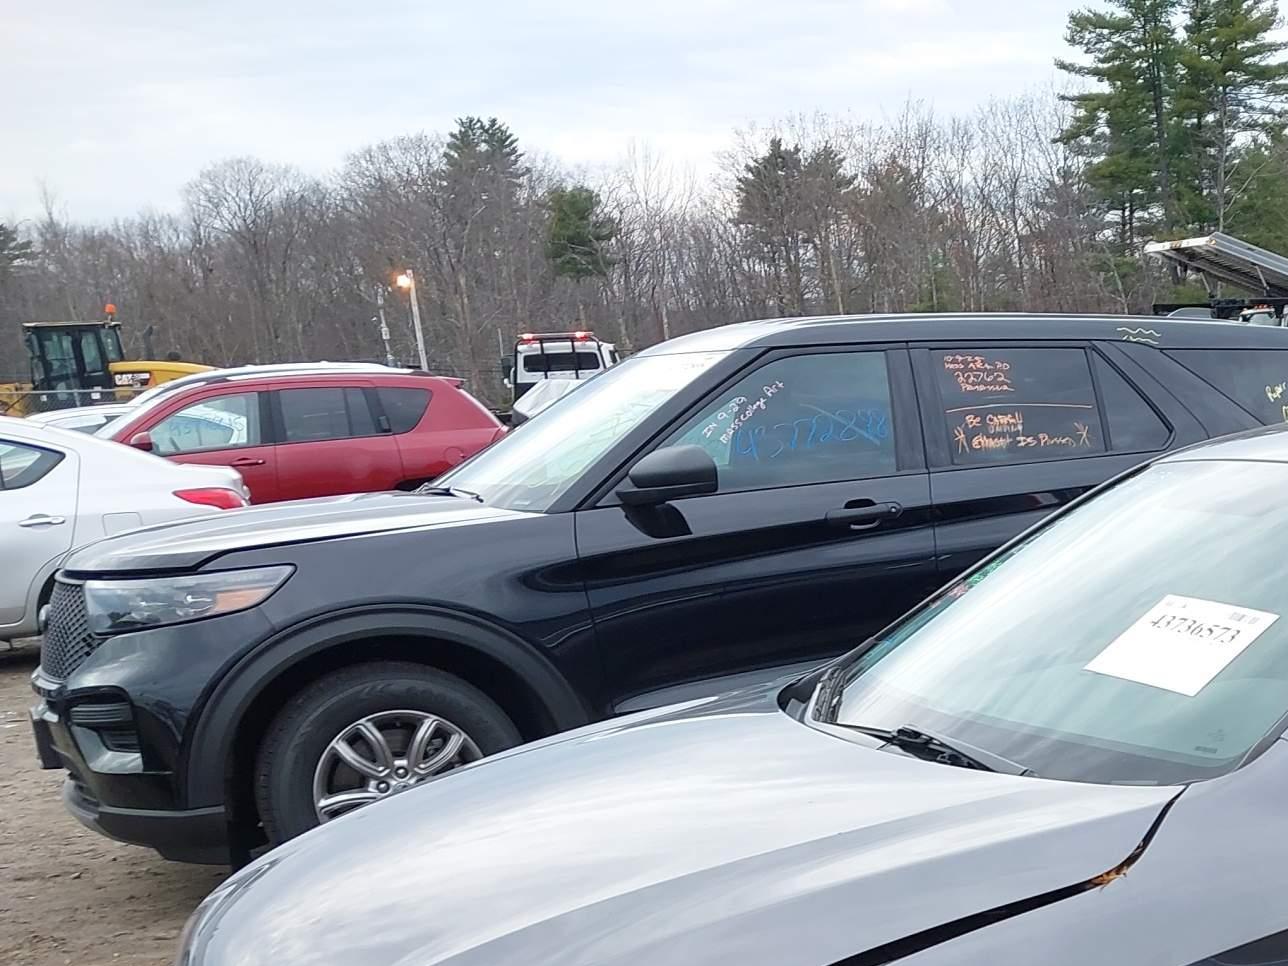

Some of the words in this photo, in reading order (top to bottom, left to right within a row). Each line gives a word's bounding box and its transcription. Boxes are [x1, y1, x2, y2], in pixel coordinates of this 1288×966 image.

[953, 371, 1012, 383] 22762
[763, 380, 785, 397] Art
[1150, 614, 1240, 643] 43736573
